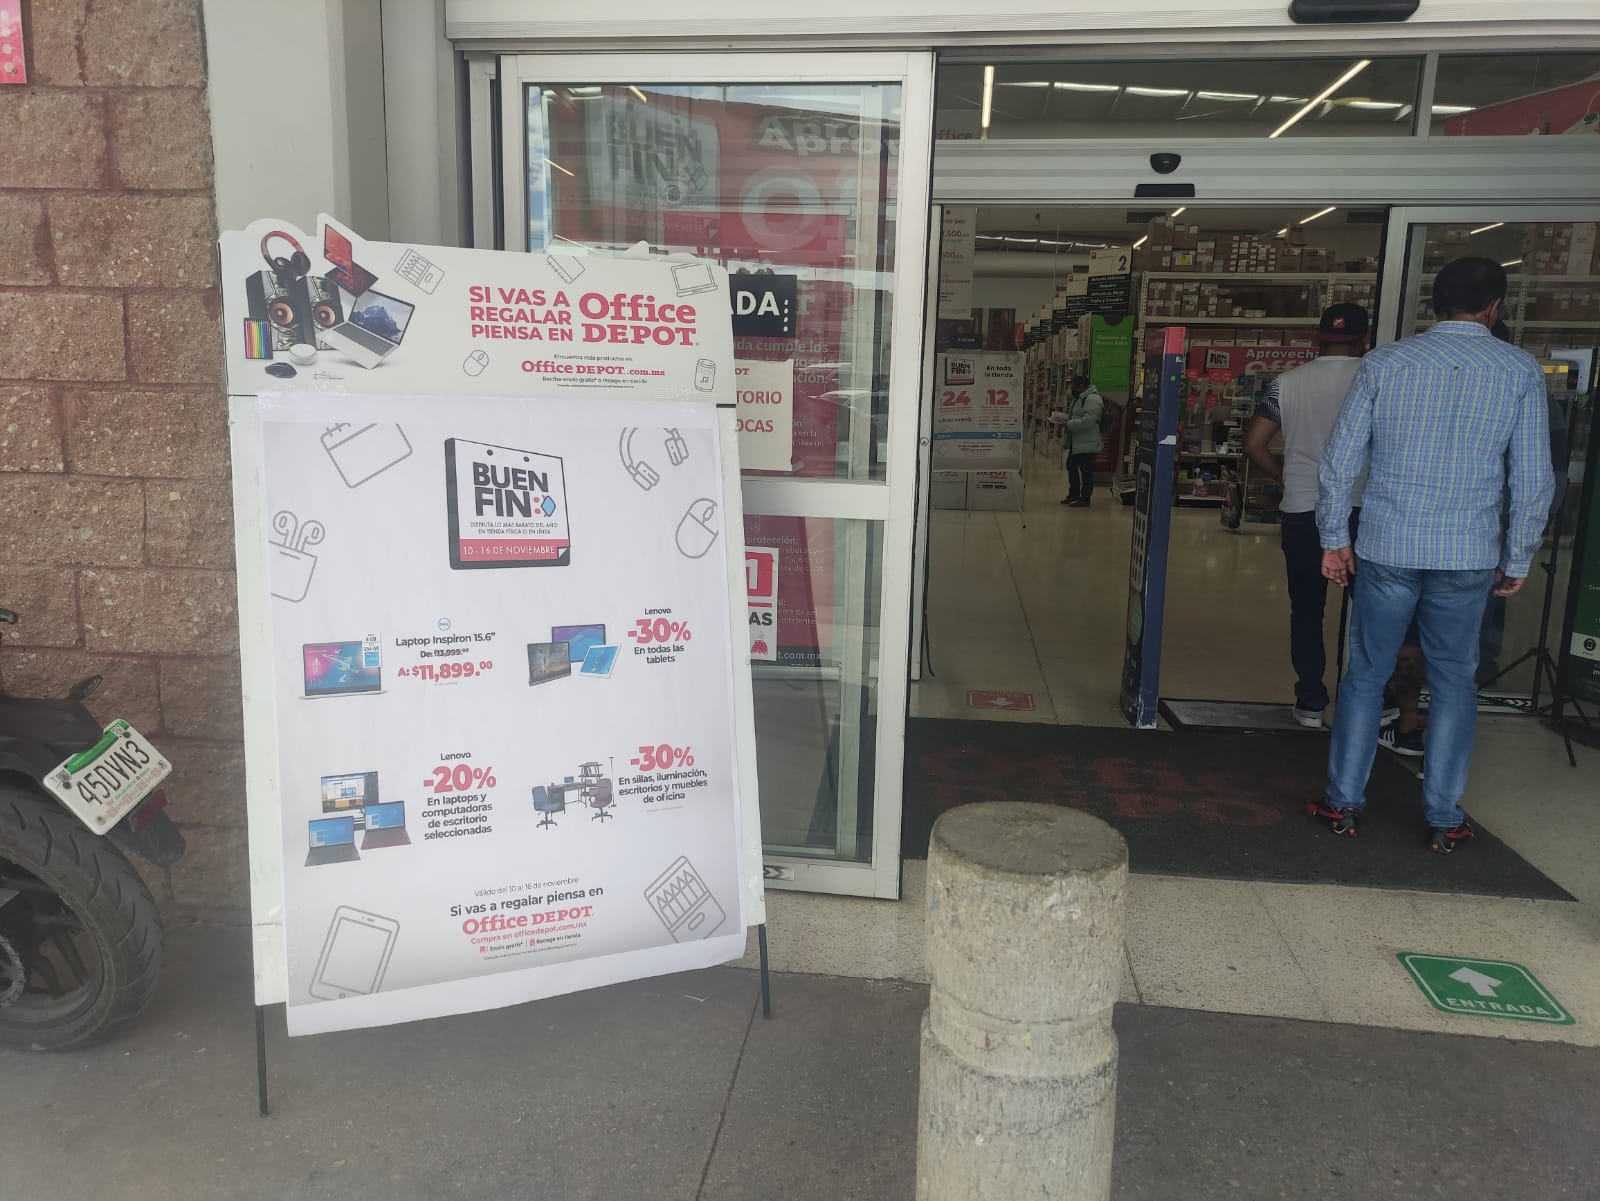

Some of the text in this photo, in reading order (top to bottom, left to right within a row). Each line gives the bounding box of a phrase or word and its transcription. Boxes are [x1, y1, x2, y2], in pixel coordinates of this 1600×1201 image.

[1118, 255, 1127, 271] 2
[469, 286, 570, 307] SI VAS A
[731, 290, 780, 317] DA
[470, 306, 572, 325] REGALAR
[579, 292, 697, 324] Office
[471, 324, 573, 342] PIENSA EN
[581, 323, 698, 346] DEPOT
[756, 339, 807, 354] cumple
[810, 339, 829, 353] los
[521, 360, 573, 374] Office
[942, 391, 971, 407] 24
[986, 390, 1009, 405] 12
[473, 462, 549, 492] BUEN
[475, 487, 532, 518] FIN
[463, 546, 473, 555] 10
[481, 546, 491, 554] 16
[493, 546, 504, 554] DE
[506, 545, 555, 555] NOVIEMBRE
[627, 617, 692, 644] -30%
[395, 637, 431, 648] Laptop
[433, 634, 472, 645] Inspiron
[420, 650, 433, 658] De:
[634, 644, 685, 655] En todas las
[646, 655, 676, 664] tablets
[397, 667, 410, 677] A:
[441, 752, 472, 761] Lenovo
[630, 744, 695, 771] -30%
[77, 740, 150, 805] 45DVN3
[423, 764, 497, 793] -20%
[619, 769, 707, 785] En sillas, iluminación,
[618, 779, 708, 796] escritorios y muebles
[427, 793, 487, 806] En laptops y
[643, 792, 686, 804] de oficina
[421, 803, 493, 818] computadoras
[428, 813, 488, 829] de escritorio
[424, 825, 493, 841] seleccionadas
[474, 887, 497, 897] Válido
[497, 886, 508, 894] del
[509, 885, 517, 893] 10
[533, 881, 542, 889] de
[543, 876, 579, 888] noviembre
[450, 886, 604, 917] Si vas a regalar piensa en
[462, 905, 593, 935] Office DEPOT
[470, 921, 588, 946] Compra en officedepot.com.mx
[1446, 997, 1551, 1016] ENTRADA
